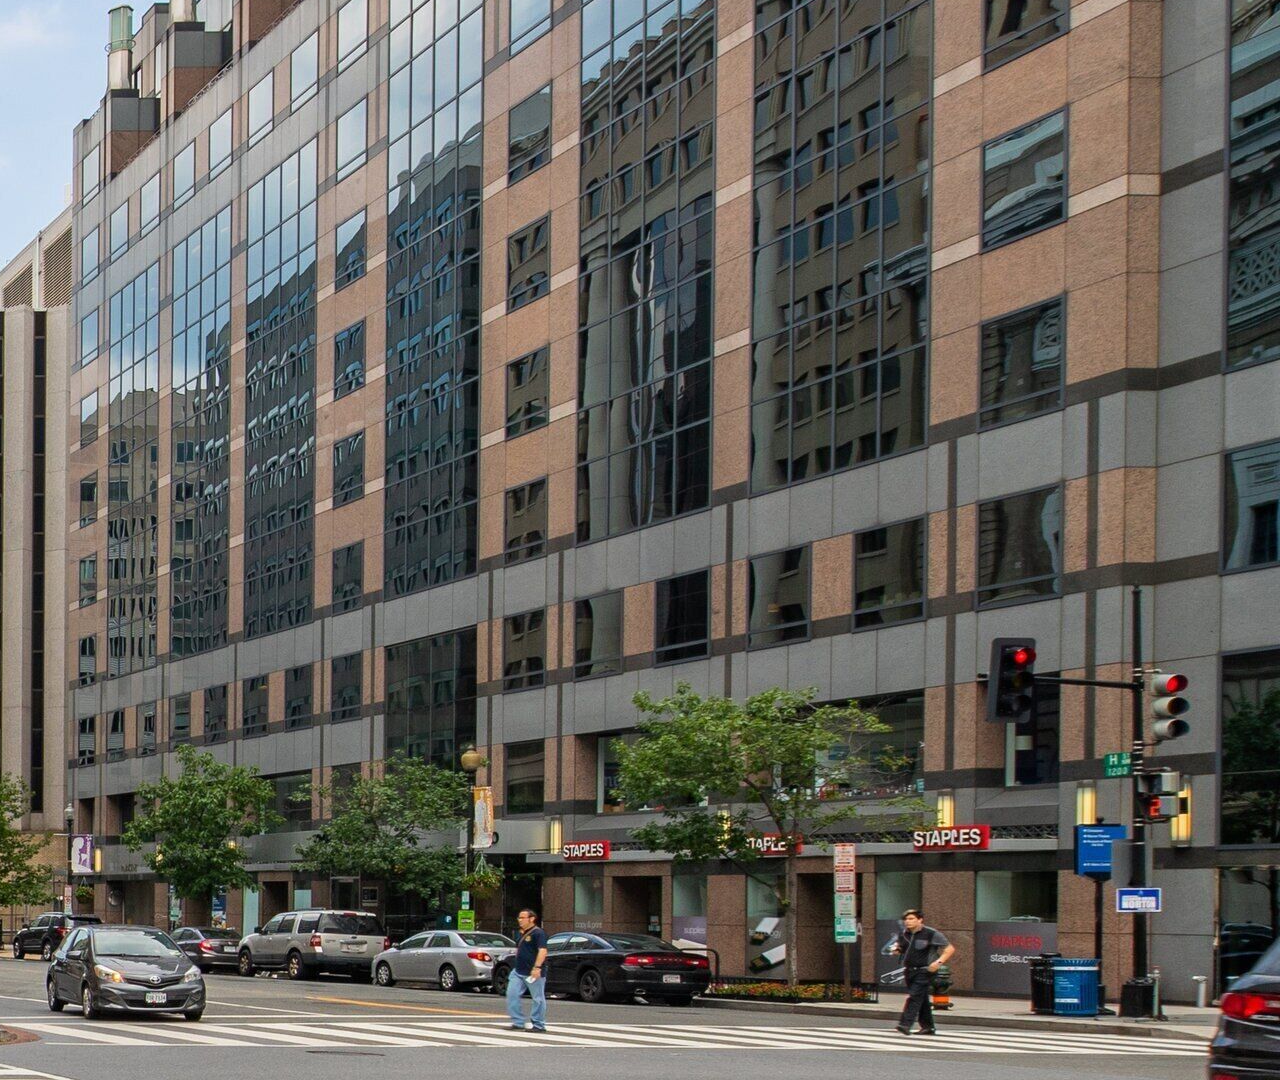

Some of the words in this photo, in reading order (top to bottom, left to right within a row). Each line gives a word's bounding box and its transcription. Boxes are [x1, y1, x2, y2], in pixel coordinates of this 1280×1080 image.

[1109, 754, 1118, 765] H
[913, 828, 981, 846] STAPLES
[563, 843, 604, 858] STAPLES
[991, 935, 1042, 949] STAPLES
